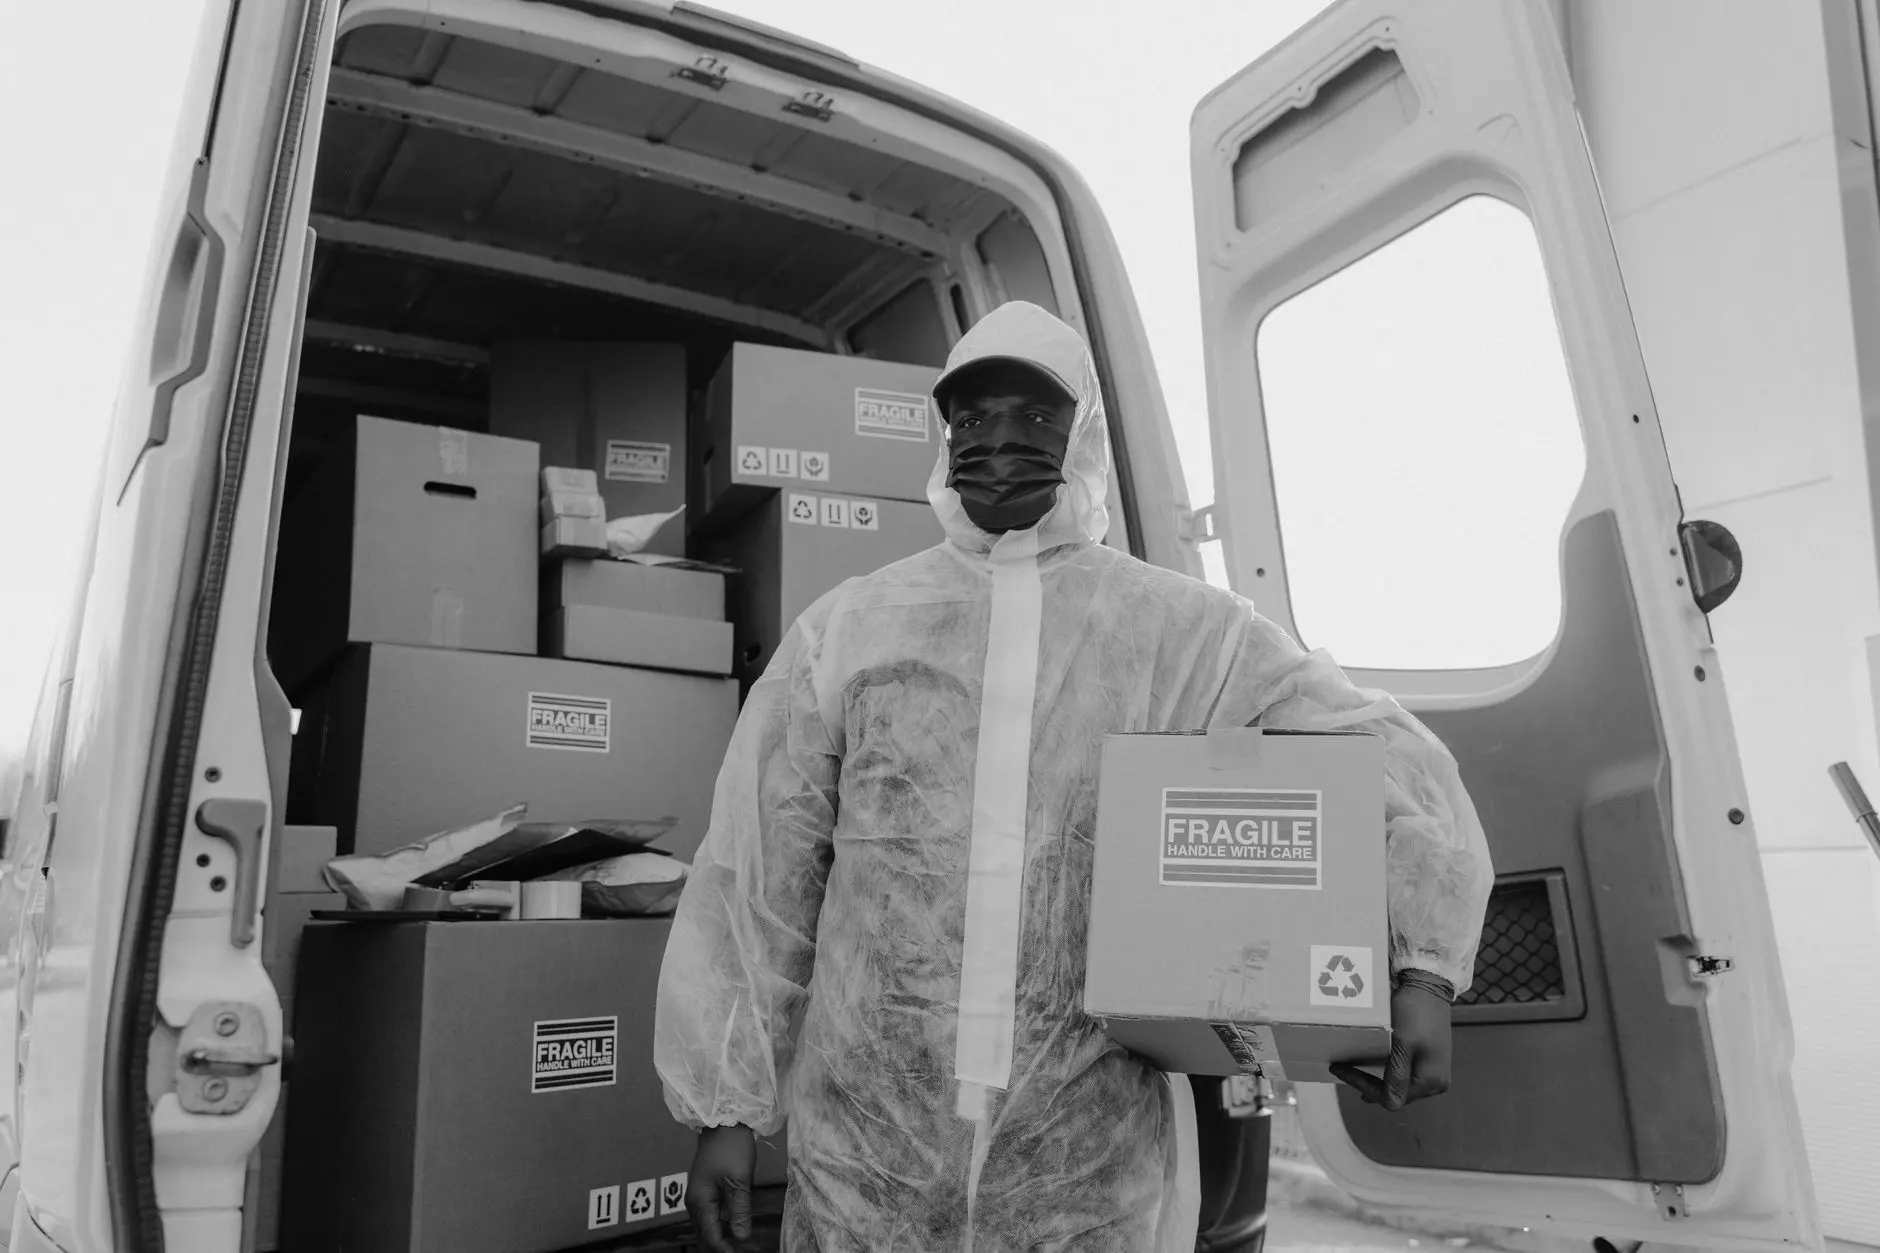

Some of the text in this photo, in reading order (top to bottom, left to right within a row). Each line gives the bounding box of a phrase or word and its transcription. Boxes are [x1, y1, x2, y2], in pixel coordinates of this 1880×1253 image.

[860, 403, 924, 421] FRAGILE
[532, 709, 605, 728] FRAGILE
[1168, 819, 1312, 845] FRAGILE
[1167, 845, 1312, 859] HANDLE WITH CARE
[537, 1038, 613, 1062] FRAGILE
[537, 1056, 612, 1071] HANDLE WITH CARE
